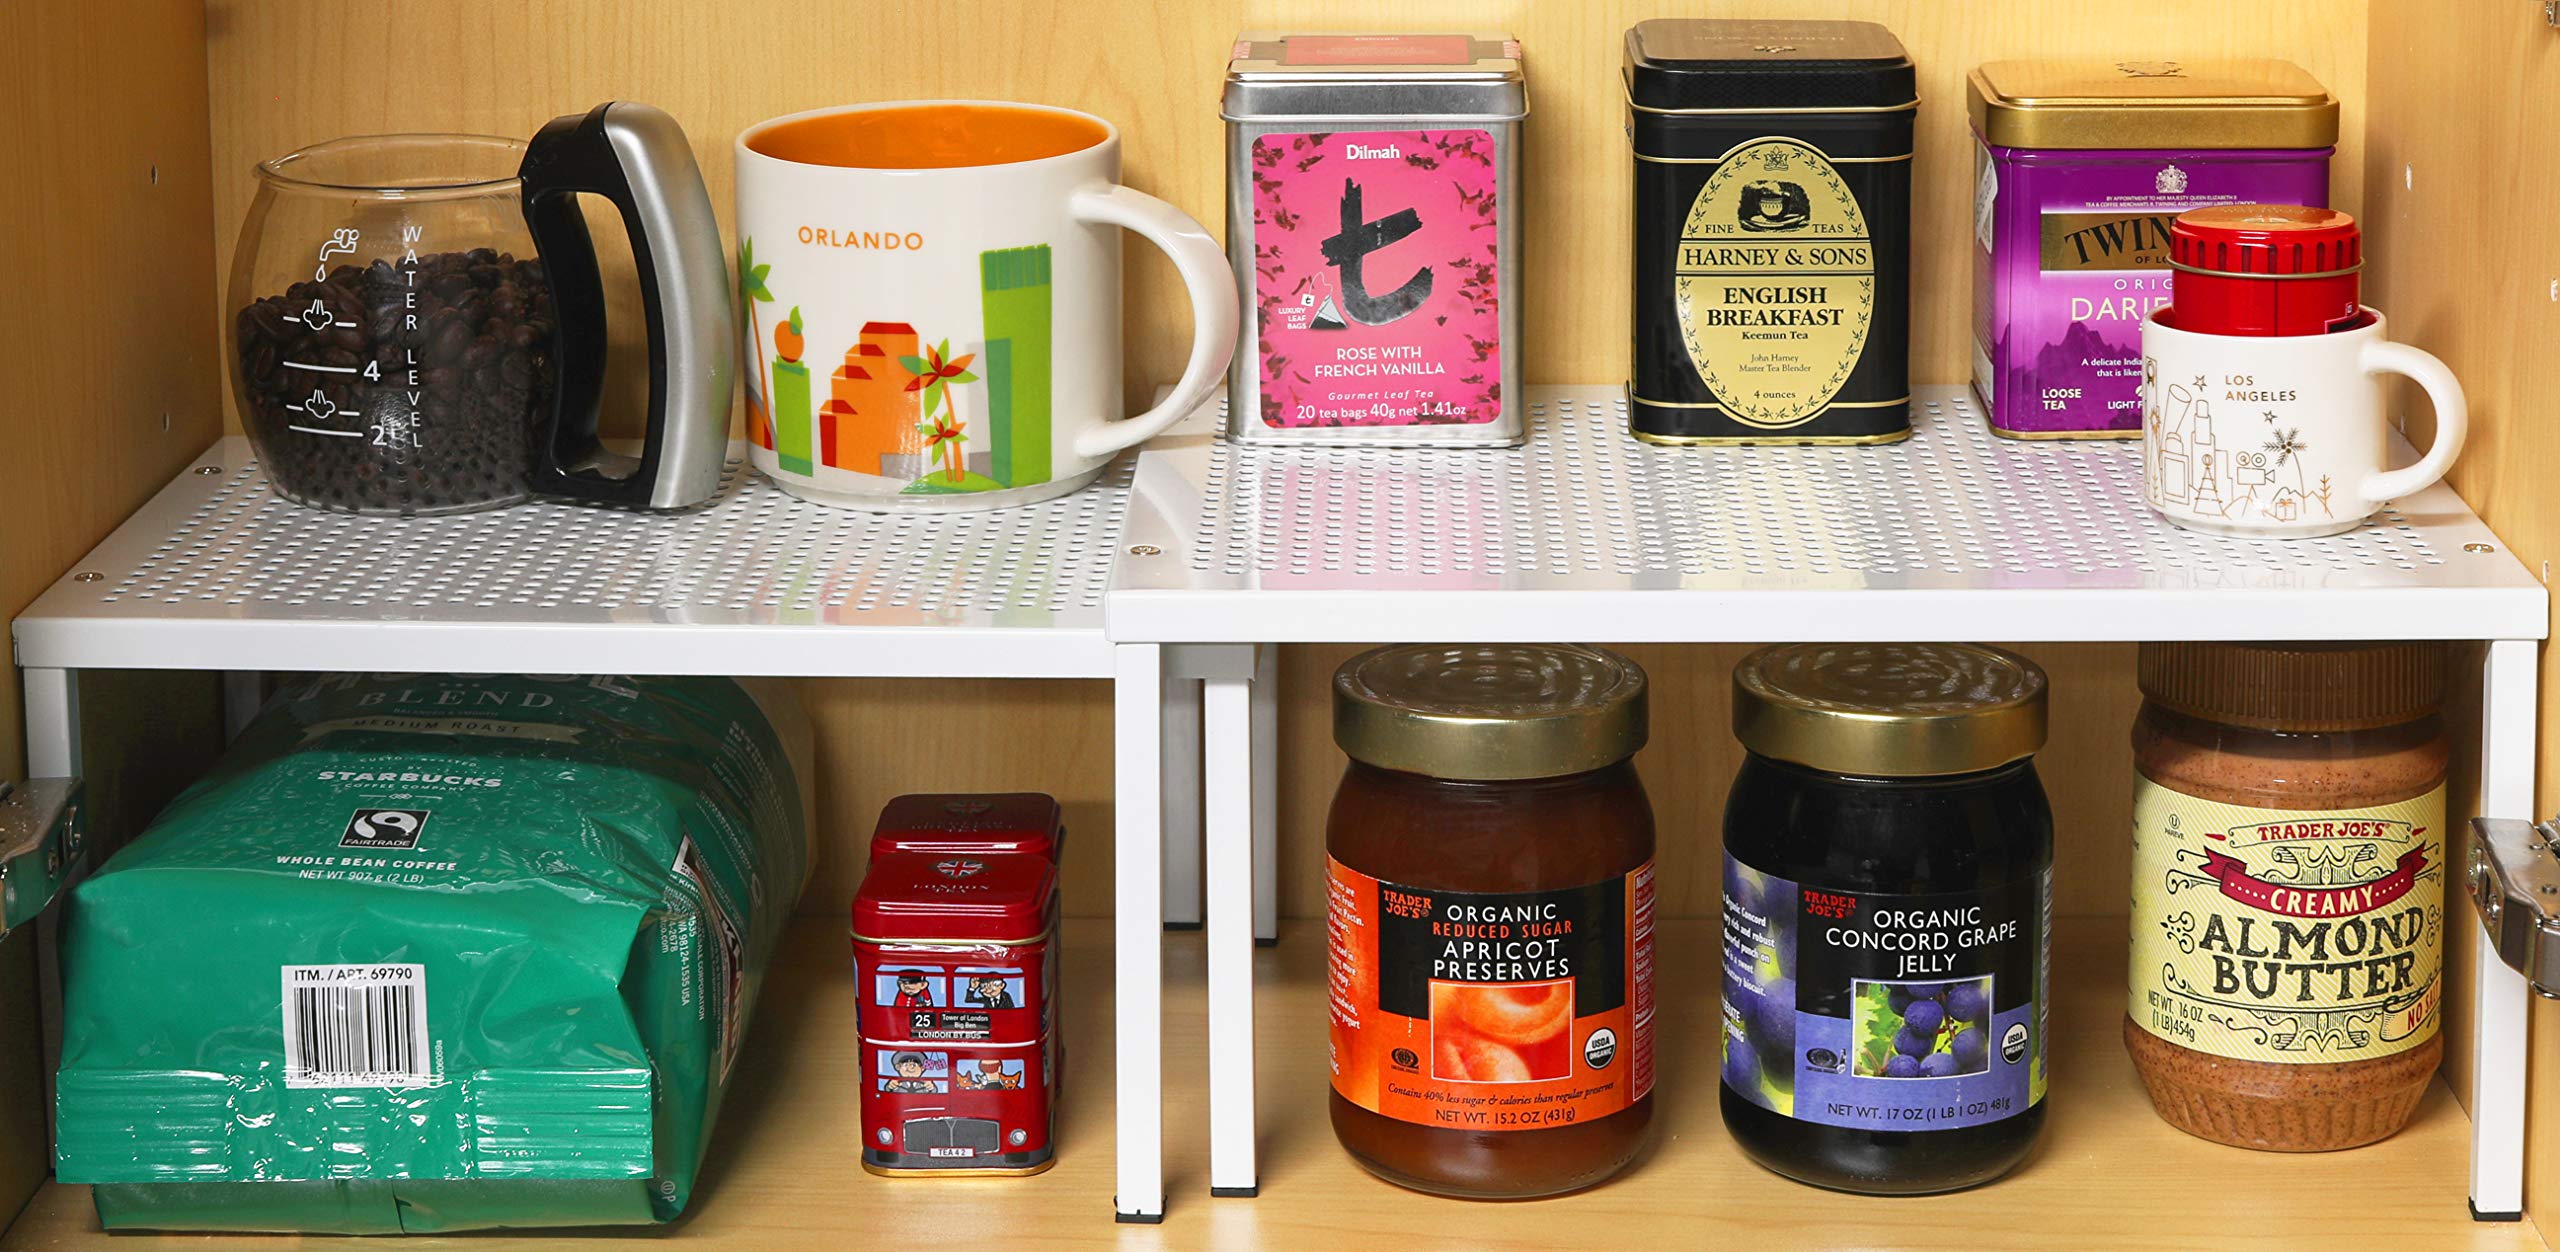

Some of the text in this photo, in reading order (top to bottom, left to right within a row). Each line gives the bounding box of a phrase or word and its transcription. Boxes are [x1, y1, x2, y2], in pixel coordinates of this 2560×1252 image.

[1346, 144, 1400, 160] Dilmah
[1705, 224, 1844, 234] FINE TEAS
[798, 226, 924, 250] ORLANDO
[1684, 248, 1867, 266] HARNEY & SONS
[2135, 256, 2150, 264] OF
[1723, 286, 1827, 305] ENGLISH
[1278, 307, 1306, 315] LUXURY
[1706, 308, 1844, 327] BREAKFAST
[1287, 322, 1306, 330] BAGS
[1742, 331, 1808, 341] Keemun Tea
[1336, 346, 1422, 361] ROSE WITH
[1751, 353, 1799, 365] John Harney
[1314, 362, 1446, 378] FRENCH VANILLA
[1739, 363, 1811, 373] Master Tea Blender
[2081, 358, 2122, 366] A delicate
[363, 360, 381, 382] 4
[2096, 368, 2121, 377] that is
[2225, 376, 2254, 386] LOS
[1328, 389, 1434, 401] Gourmet Leaf Tea
[1754, 390, 1796, 400] 4 ounces
[2042, 389, 2082, 399] LOOSE
[2225, 390, 2296, 402] ANGELES
[1297, 405, 1315, 419] 20
[1319, 408, 1338, 419] tea
[1341, 406, 1368, 421] bags
[1370, 403, 1396, 420] 40g
[1399, 405, 1418, 417] net
[2043, 401, 2066, 410] TEA
[2107, 401, 2135, 410] LIGHT
[371, 426, 387, 446] 2
[357, 689, 554, 708] BLEND
[352, 718, 521, 734] MEDIUM ROAST
[317, 771, 502, 787] STARBUCKS
[401, 784, 466, 792] COMPANY
[2257, 823, 2333, 842] TRADER
[344, 839, 411, 847] FAIRTRADE
[277, 855, 457, 871] WHOLE BEAN COFFEE
[299, 869, 322, 880] NET
[327, 871, 344, 880] WT
[387, 874, 398, 883] (2
[403, 875, 424, 884] LB)
[1384, 889, 1433, 909] TRADER
[1804, 890, 1856, 909] TRADER
[2270, 885, 2373, 915] CREAMY
[1446, 903, 1557, 924] ORGANIC
[1741, 906, 1766, 927] Concord
[1874, 907, 1980, 929] ORGANIC
[1433, 920, 1572, 939] REDUCED SUGAR
[1826, 920, 2017, 951] CONCORD GRAPE
[2200, 906, 2424, 961] ALMOND
[1752, 932, 1775, 948] robust
[1443, 938, 1560, 960] APRICOT
[1760, 953, 1770, 964] on
[1897, 954, 1956, 978] JELLY
[295, 970, 324, 981] ITM.
[371, 968, 412, 980] 69790
[1434, 957, 1569, 981] PRESERVES
[2212, 950, 2415, 1002] BUTTER
[942, 1013, 959, 1022] Tower
[2179, 1001, 2188, 1019] 16
[2190, 1005, 2203, 1023] OZ
[2408, 1003, 2422, 1031] NO
[915, 1014, 931, 1028] 25
[918, 1031, 951, 1039] LONDON
[1592, 1036, 1610, 1049] USDA
[1388, 1082, 1422, 1099] Contains
[1424, 1091, 1444, 1101] 40%
[1446, 1094, 1459, 1104] less
[1461, 1096, 1486, 1107] sugar
[1500, 1094, 1532, 1106] calories
[1534, 1092, 1553, 1104] than
[1556, 1089, 1583, 1103] regular
[1436, 1107, 1576, 1125] NET WT. 15.2 OZ (431g)
[1828, 1103, 1852, 1116] NET
[1856, 1106, 1882, 1119] WT.
[1887, 1109, 1899, 1119] 17
[1903, 1108, 1923, 1120] OZ
[1941, 1106, 1955, 1119] LB
[1967, 1101, 1988, 1116] OZ)
